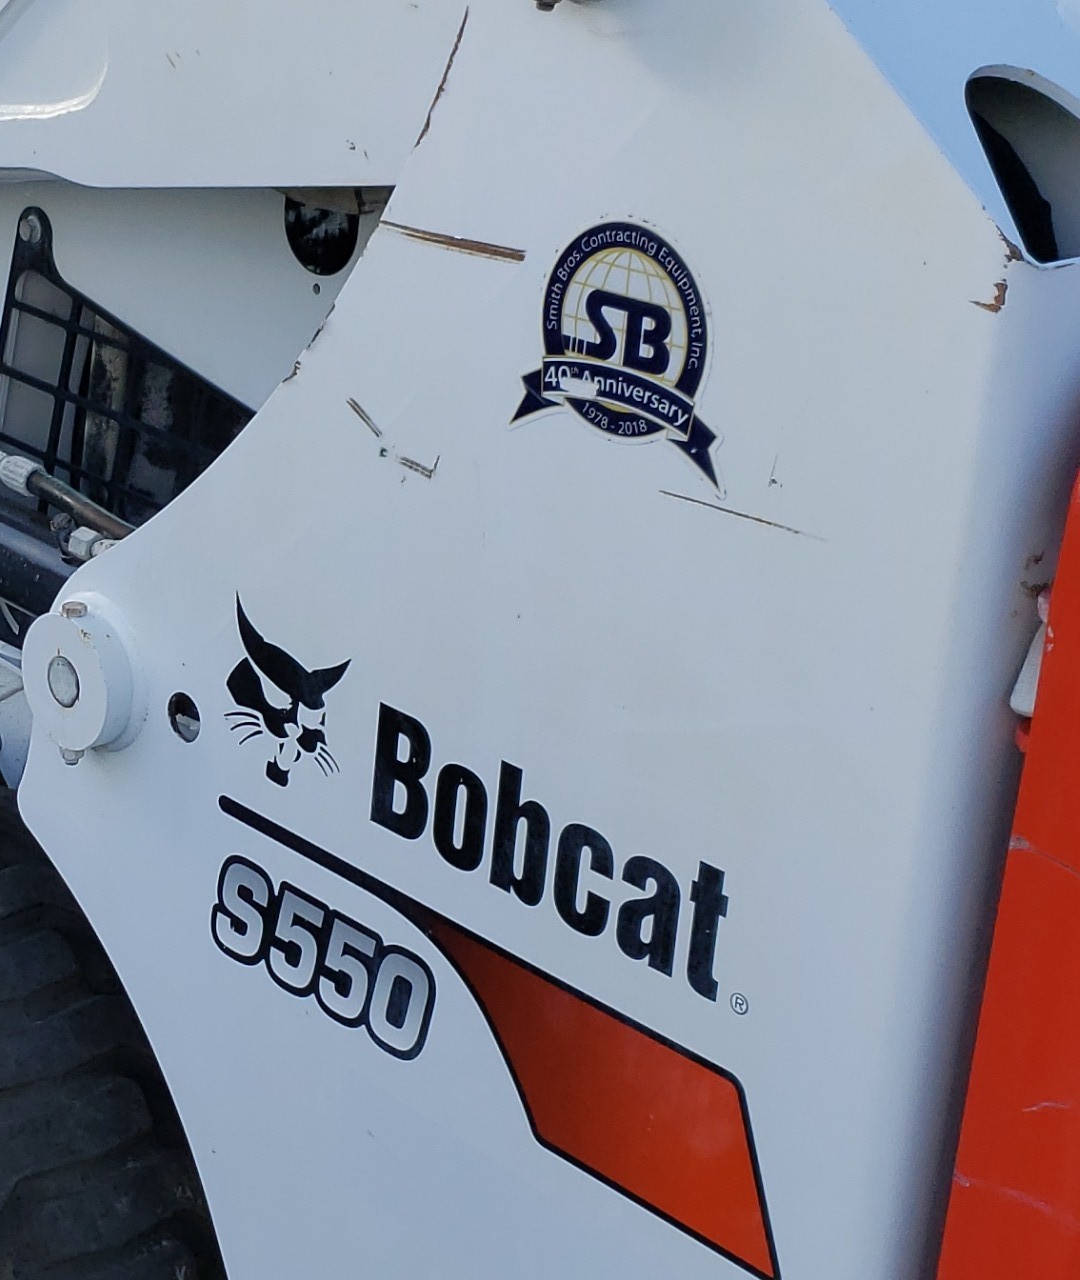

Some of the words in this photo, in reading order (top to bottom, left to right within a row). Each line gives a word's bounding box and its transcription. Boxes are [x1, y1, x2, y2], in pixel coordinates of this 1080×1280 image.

[547, 283, 563, 330] Smith
[557, 252, 584, 281] Bros.
[581, 230, 657, 257] Contracting
[657, 246, 703, 339] Equipment,
[688, 342, 704, 370] Inc.
[562, 289, 672, 375] SB
[582, 402, 608, 429] 1978
[618, 419, 647, 435] 2018
[369, 701, 729, 1003] Bobcat
[211, 854, 437, 1061] S550
